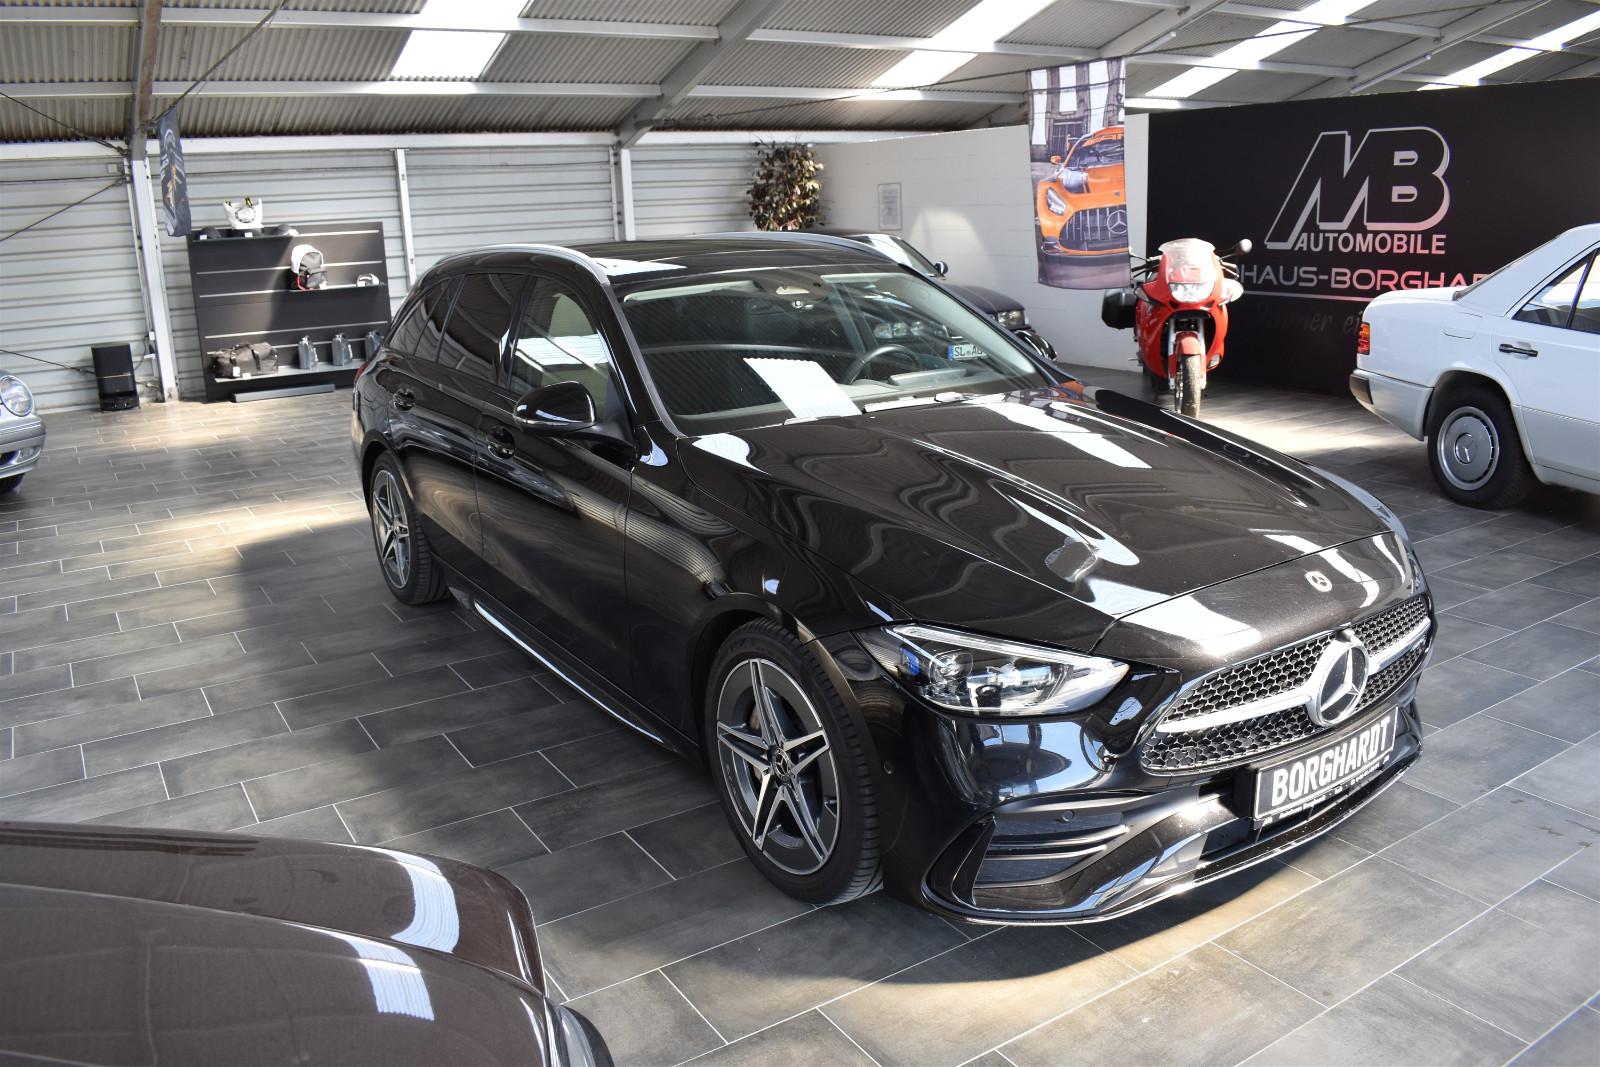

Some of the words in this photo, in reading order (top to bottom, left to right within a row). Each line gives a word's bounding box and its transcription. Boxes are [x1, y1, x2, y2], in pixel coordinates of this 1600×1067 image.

[1264, 126, 1450, 249] MB
[1294, 232, 1447, 255] AUTOMOBILE
[1236, 263, 1488, 291] HAUS-BORGHA
[1271, 715, 1391, 807] BORGHARDT
